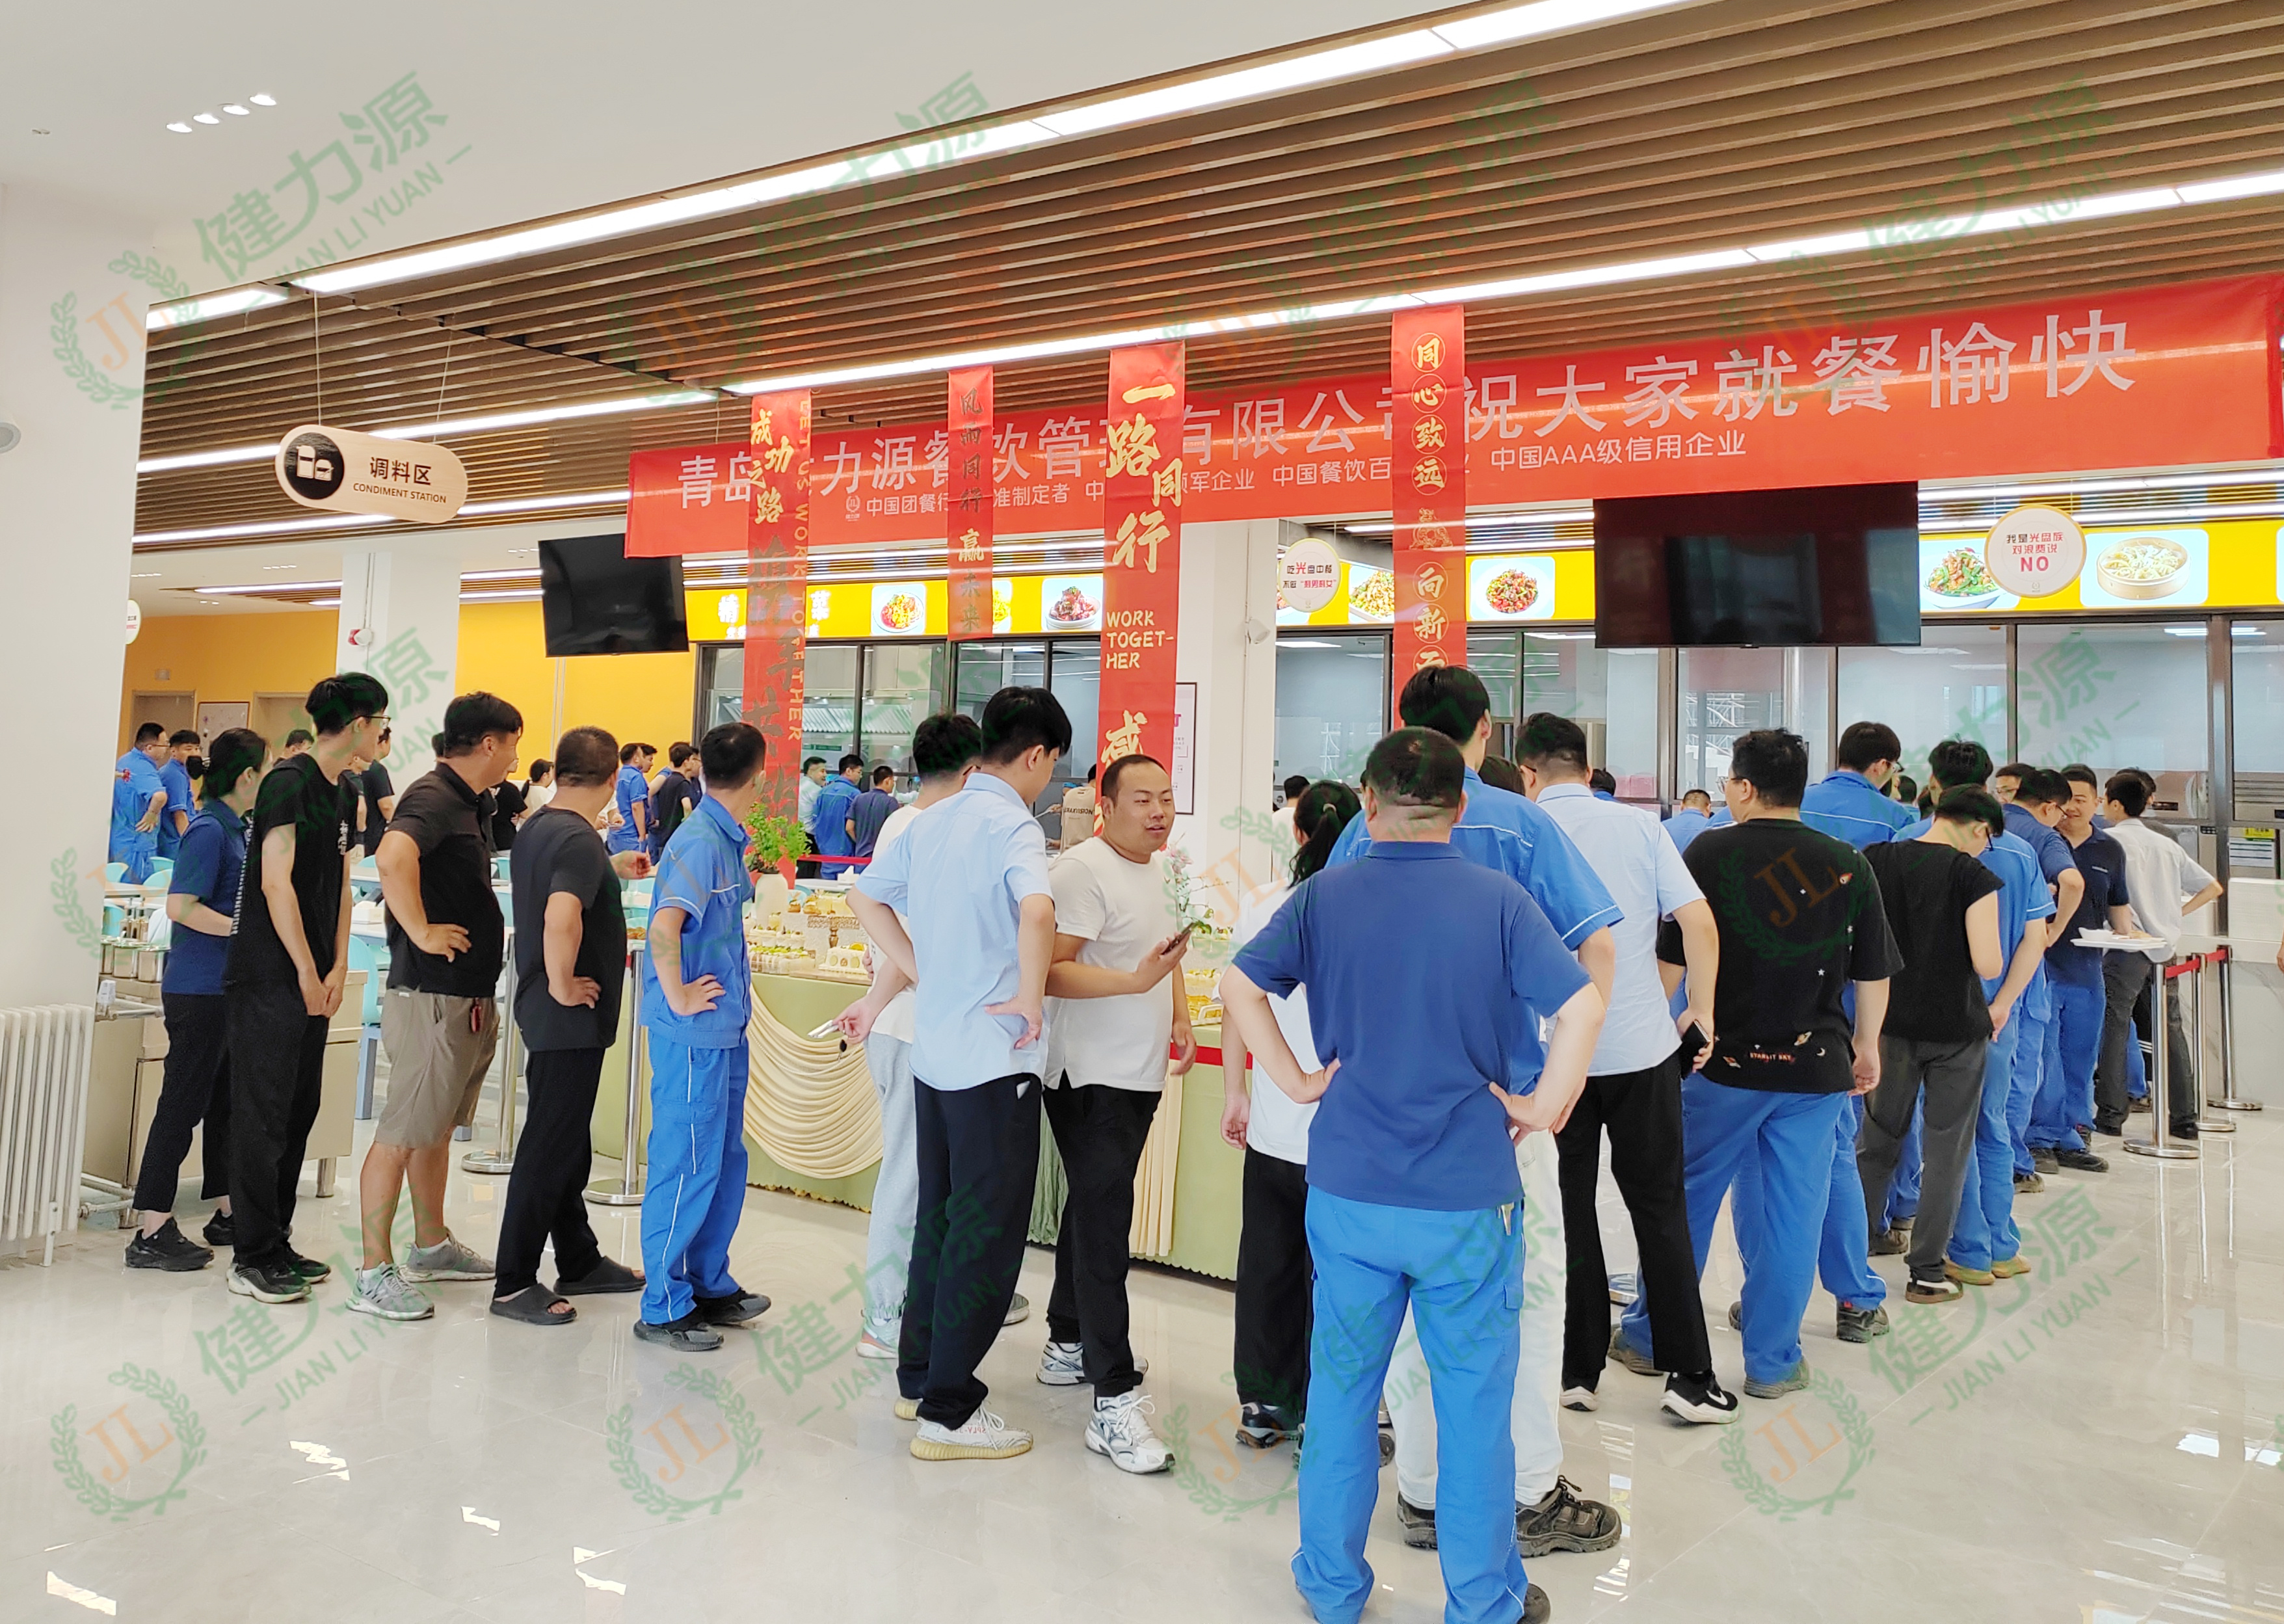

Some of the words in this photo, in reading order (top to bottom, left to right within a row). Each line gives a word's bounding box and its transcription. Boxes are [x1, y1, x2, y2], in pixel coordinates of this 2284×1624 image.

[1414, 337, 1446, 490] 同心致远
[1491, 429, 1747, 472] 中国AAA级信用企业
[369, 456, 432, 485] 调料区
[747, 408, 794, 524] 成功之路
[1106, 382, 1183, 573] 一路同行
[353, 483, 408, 498] CONDIMENT
[410, 491, 447, 503] STATION
[2006, 532, 2063, 544] 我是光盘族
[2012, 543, 2058, 555] 对浪费说
[1286, 562, 1333, 574] 吃光盘中餐
[2021, 556, 2049, 572] NO
[1106, 610, 1155, 628] WORK
[1106, 630, 1175, 648] TOGET-
[1106, 652, 1141, 669] HER
[1749, 1052, 1776, 1061] STARLIT
